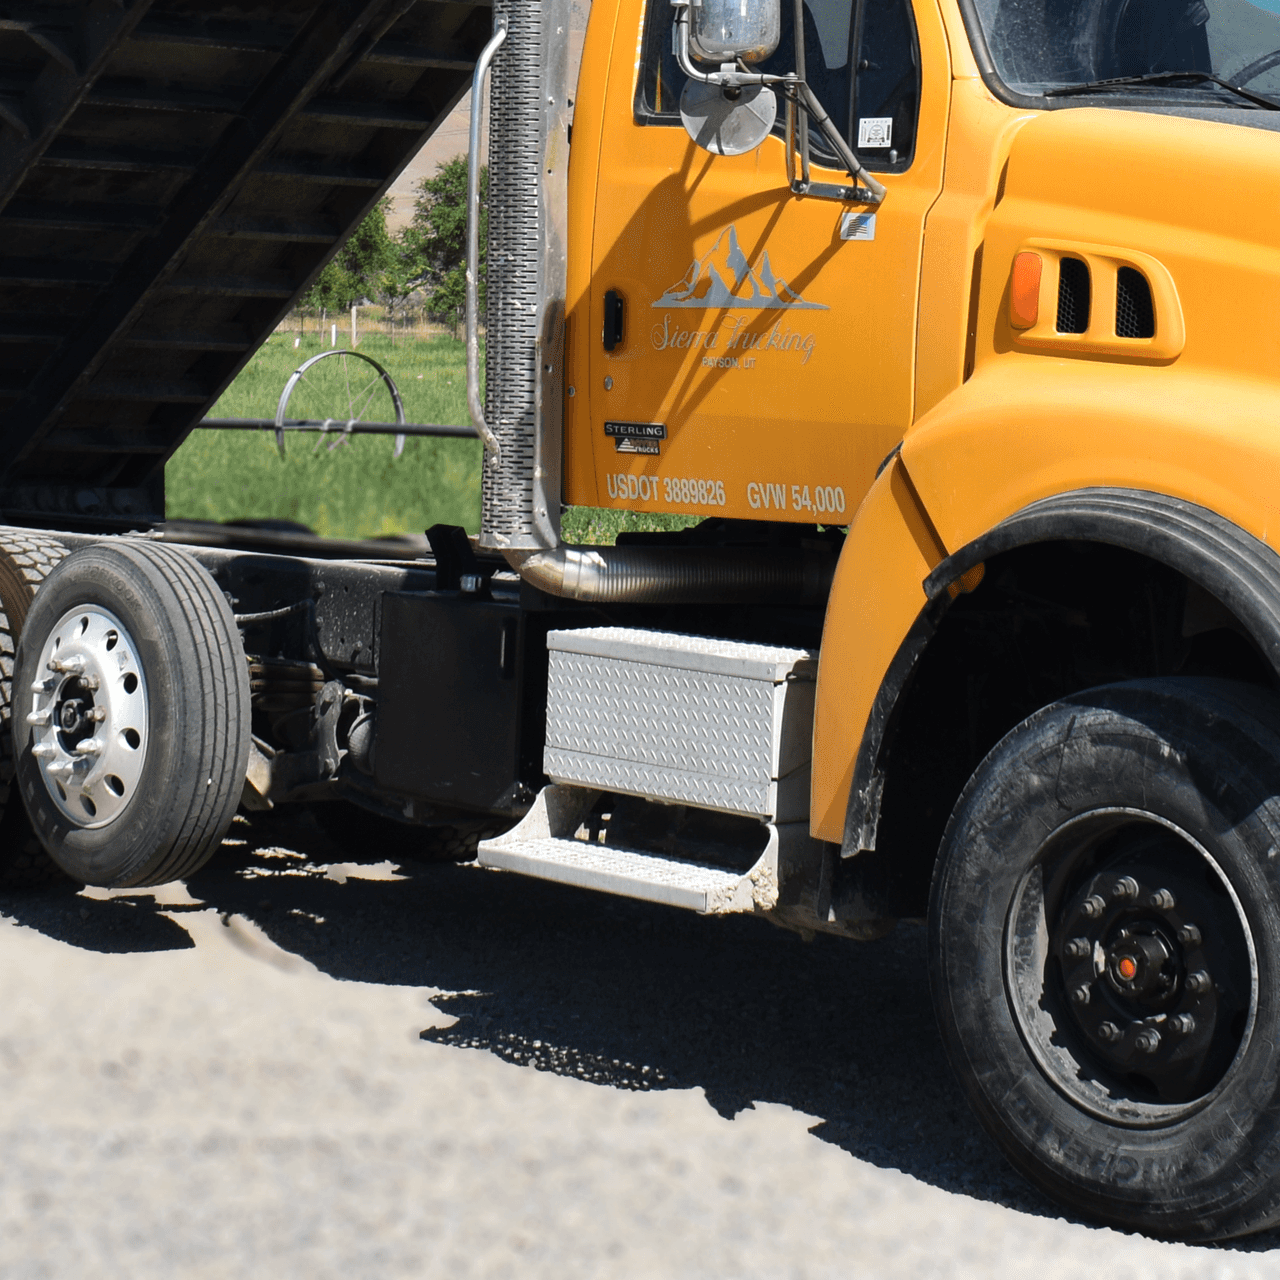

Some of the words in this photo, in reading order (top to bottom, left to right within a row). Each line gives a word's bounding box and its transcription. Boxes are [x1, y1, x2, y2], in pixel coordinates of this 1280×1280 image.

[651, 313, 719, 351] Sierra
[720, 314, 816, 365] Trucking
[743, 356, 756, 369] UT
[606, 424, 663, 436] STERLING
[635, 446, 659, 454] TRUCKS
[607, 474, 659, 501] USDOT
[663, 477, 726, 506] 3889826
[747, 482, 786, 509] GVW
[791, 485, 846, 516] 54,000
